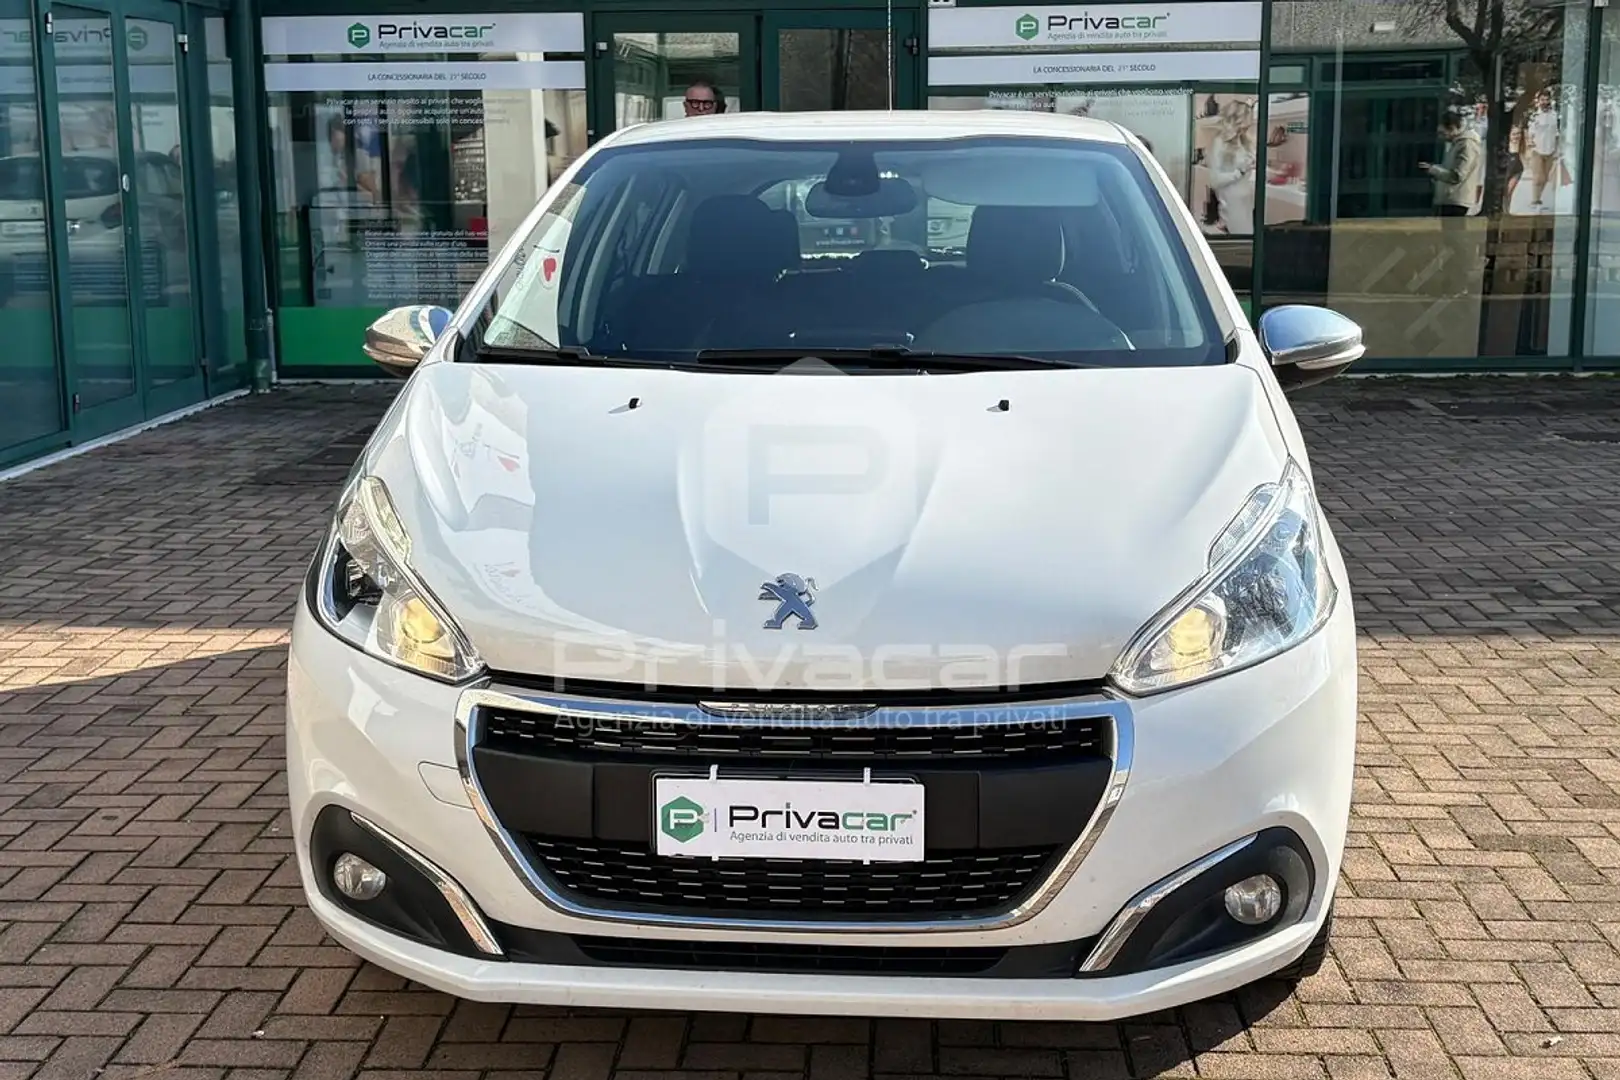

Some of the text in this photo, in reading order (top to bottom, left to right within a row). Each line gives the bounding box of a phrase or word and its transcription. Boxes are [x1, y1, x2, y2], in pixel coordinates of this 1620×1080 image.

[729, 803, 913, 832] Privacar
[730, 831, 914, 846] Agenzia di vendita auto tra privati
